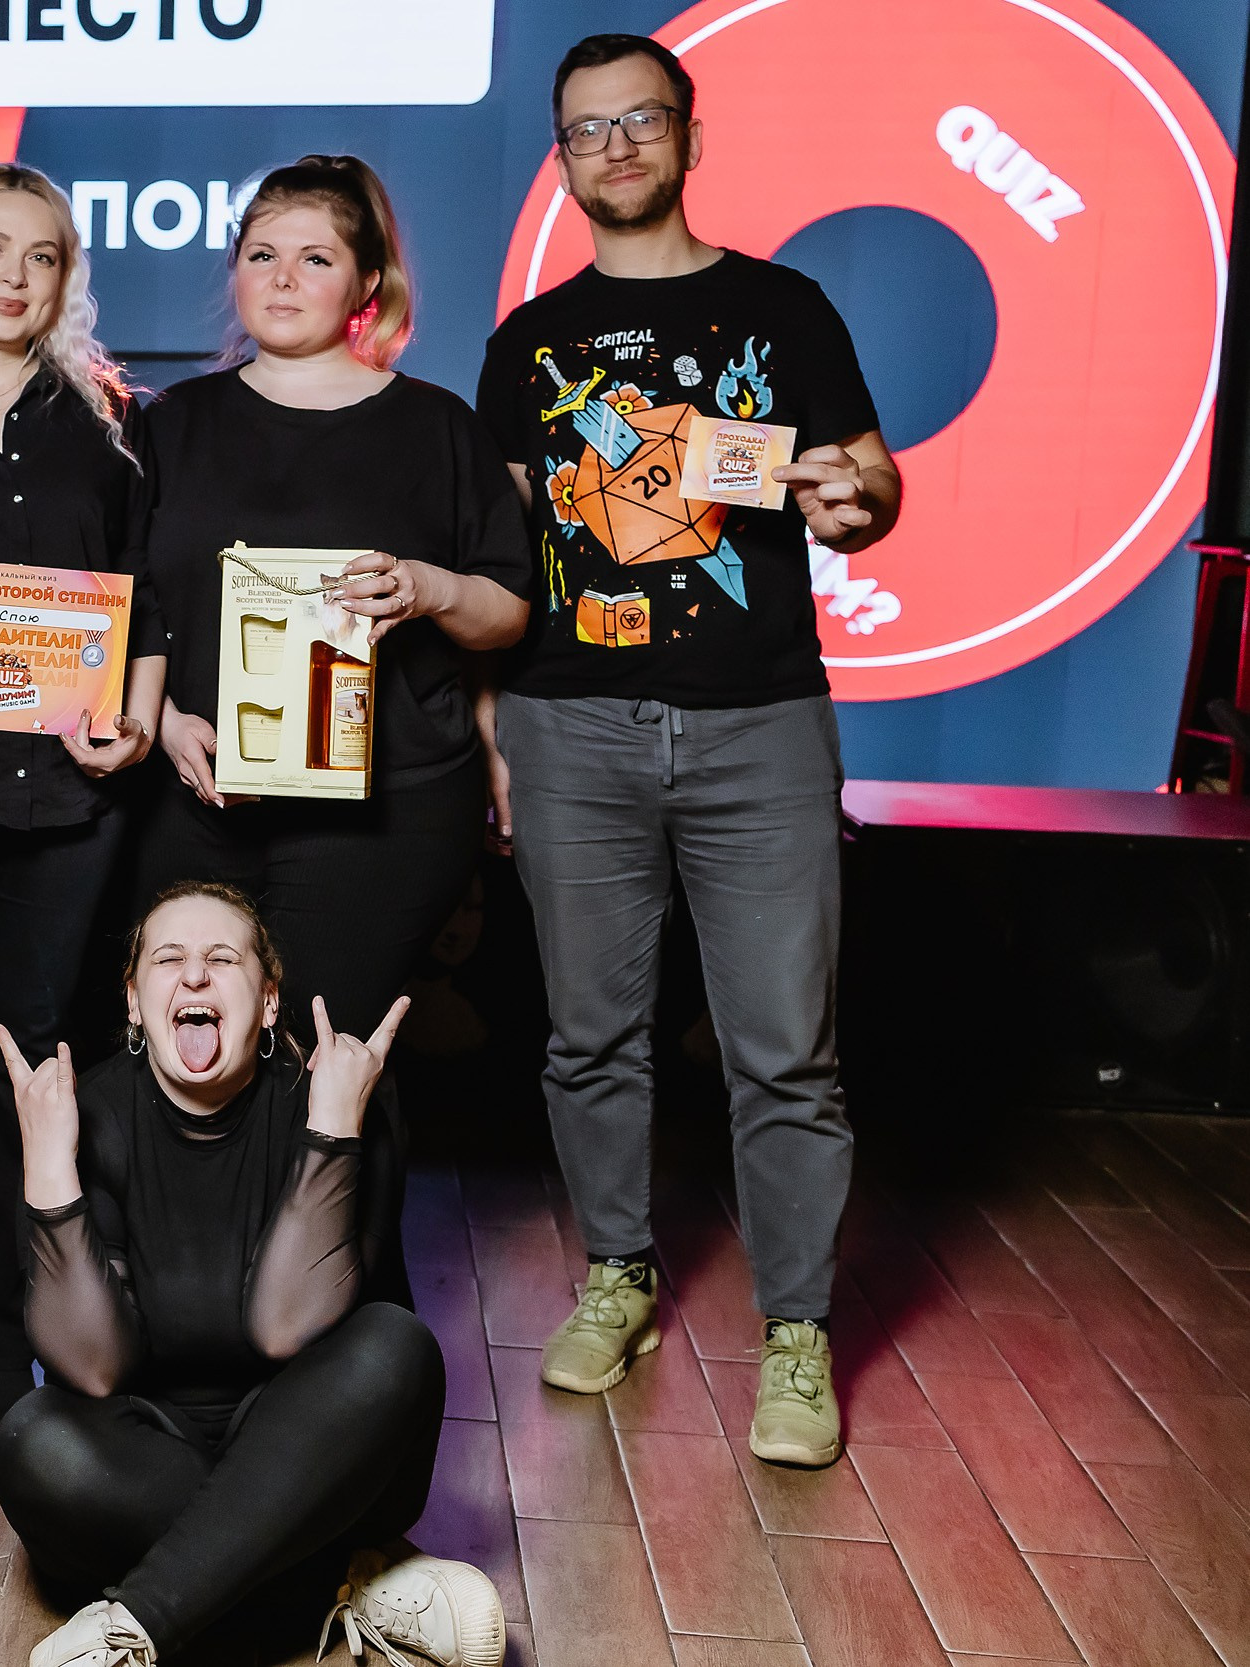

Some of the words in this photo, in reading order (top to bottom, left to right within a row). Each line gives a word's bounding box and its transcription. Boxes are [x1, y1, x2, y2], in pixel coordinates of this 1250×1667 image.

[936, 105, 1086, 243] QUIZ
[594, 329, 655, 349] CRITICAL
[614, 345, 643, 360] HIT!
[723, 459, 751, 472] QUIZ
[631, 465, 672, 500] 20
[58, 590, 126, 607] СТЕПЕНИ
[0, 610, 39, 623] Спою
[87, 648, 99, 663] 2
